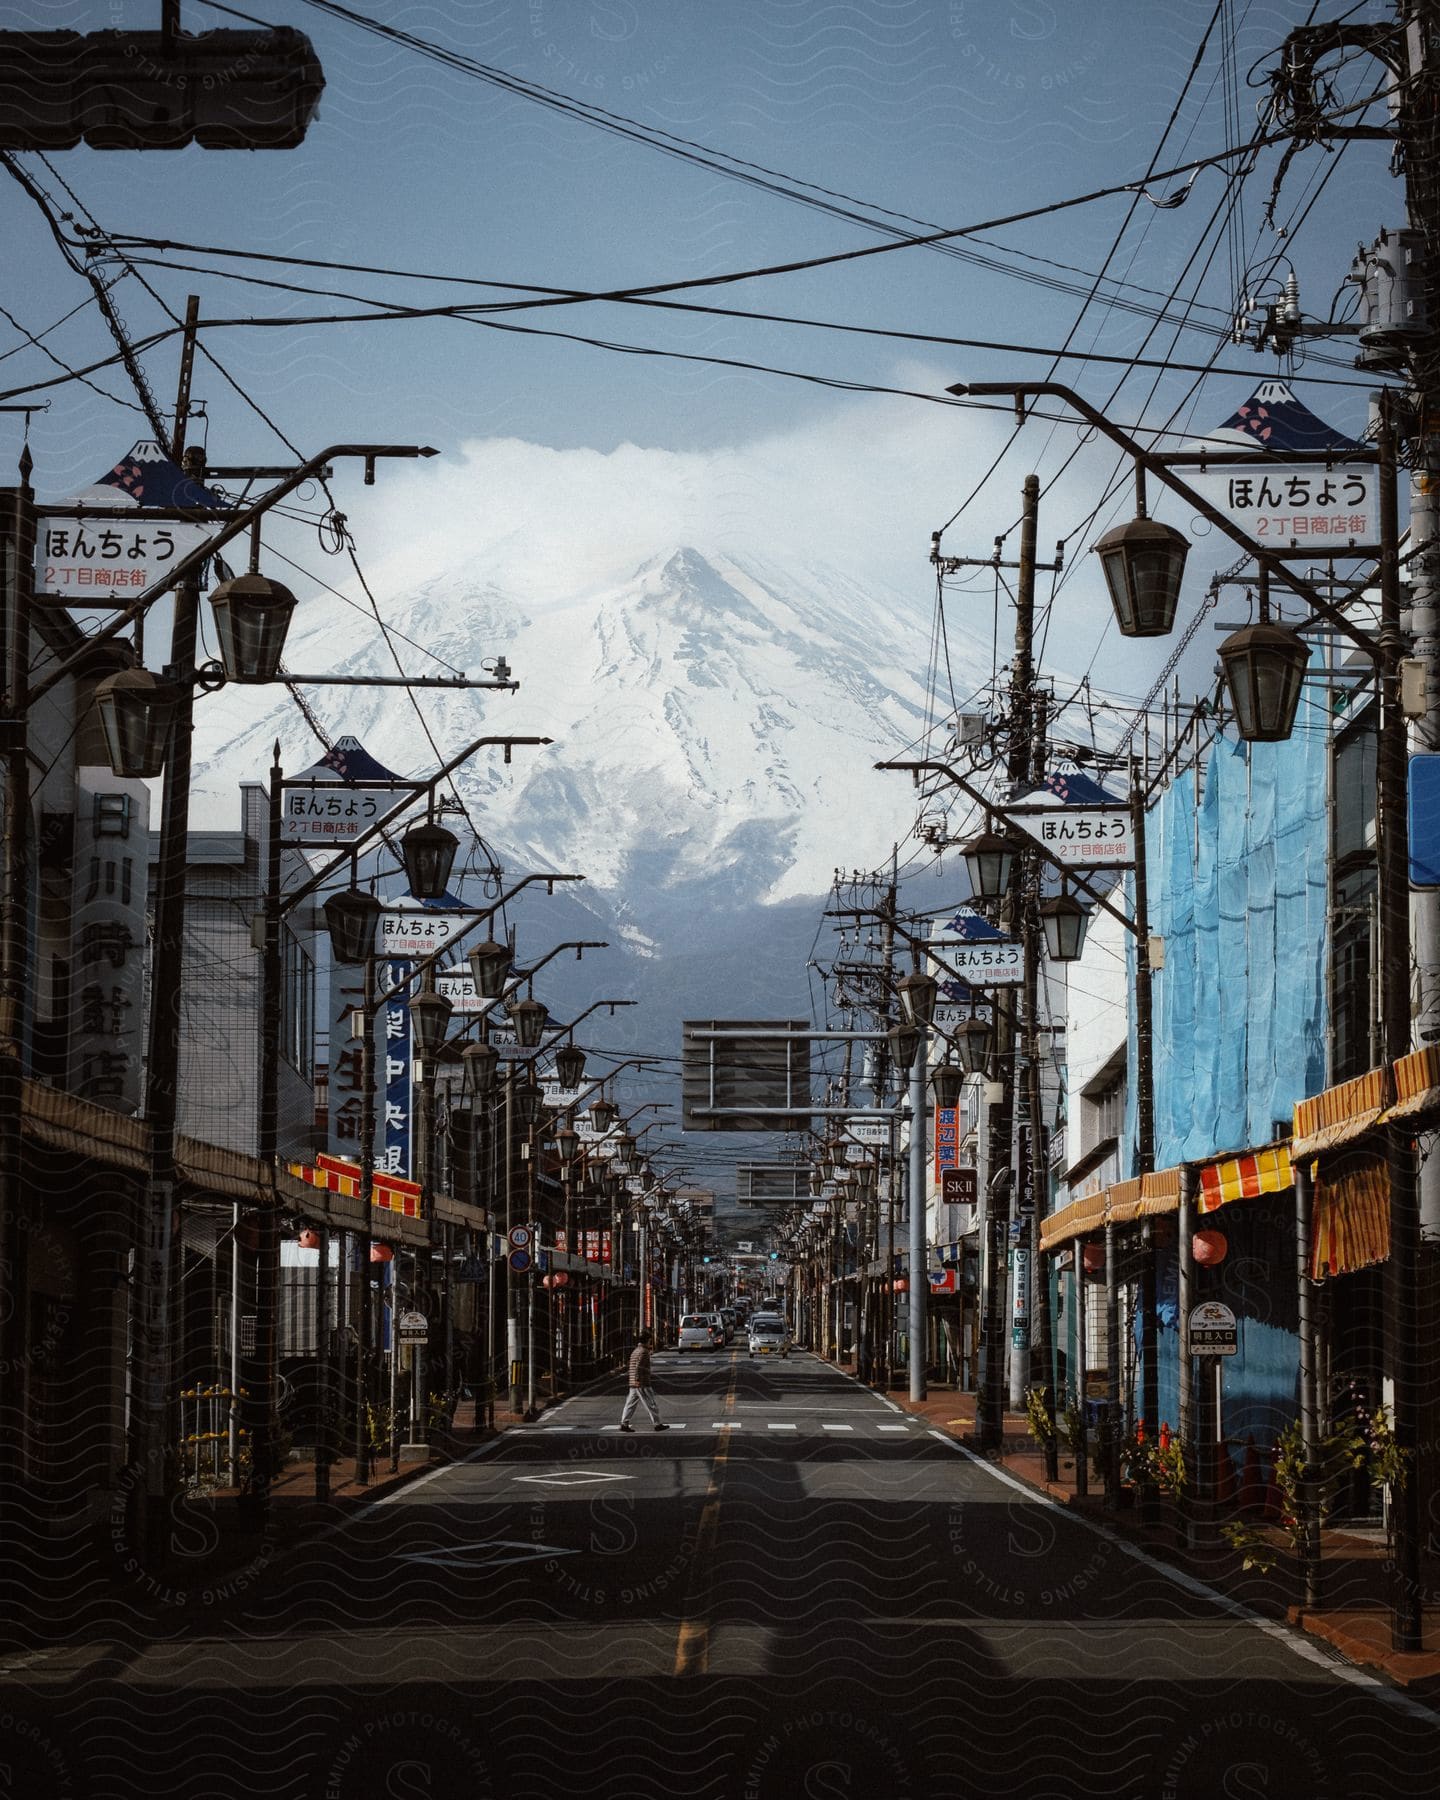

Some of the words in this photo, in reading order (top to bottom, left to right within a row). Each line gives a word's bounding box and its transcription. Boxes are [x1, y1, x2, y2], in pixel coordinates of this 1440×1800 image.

[1228, 474, 1367, 509] ほんちょう
[1256, 514, 1367, 536] 2丁目商店街
[45, 528, 175, 561] ほんちょう
[44, 566, 148, 588] 2丁目商店街
[289, 795, 377, 818] ほんちょう
[289, 821, 359, 834] 2丁目商店街
[1042, 818, 1126, 840] ほんちょう
[1059, 843, 1127, 857] 2丁目商店街
[382, 919, 450, 937] ほんちょう
[955, 948, 1019, 967] ほんちょう
[438, 982, 473, 996] ほんち
[935, 1008, 987, 1022] ほんちう
[514, 1232, 528, 1243] 40
